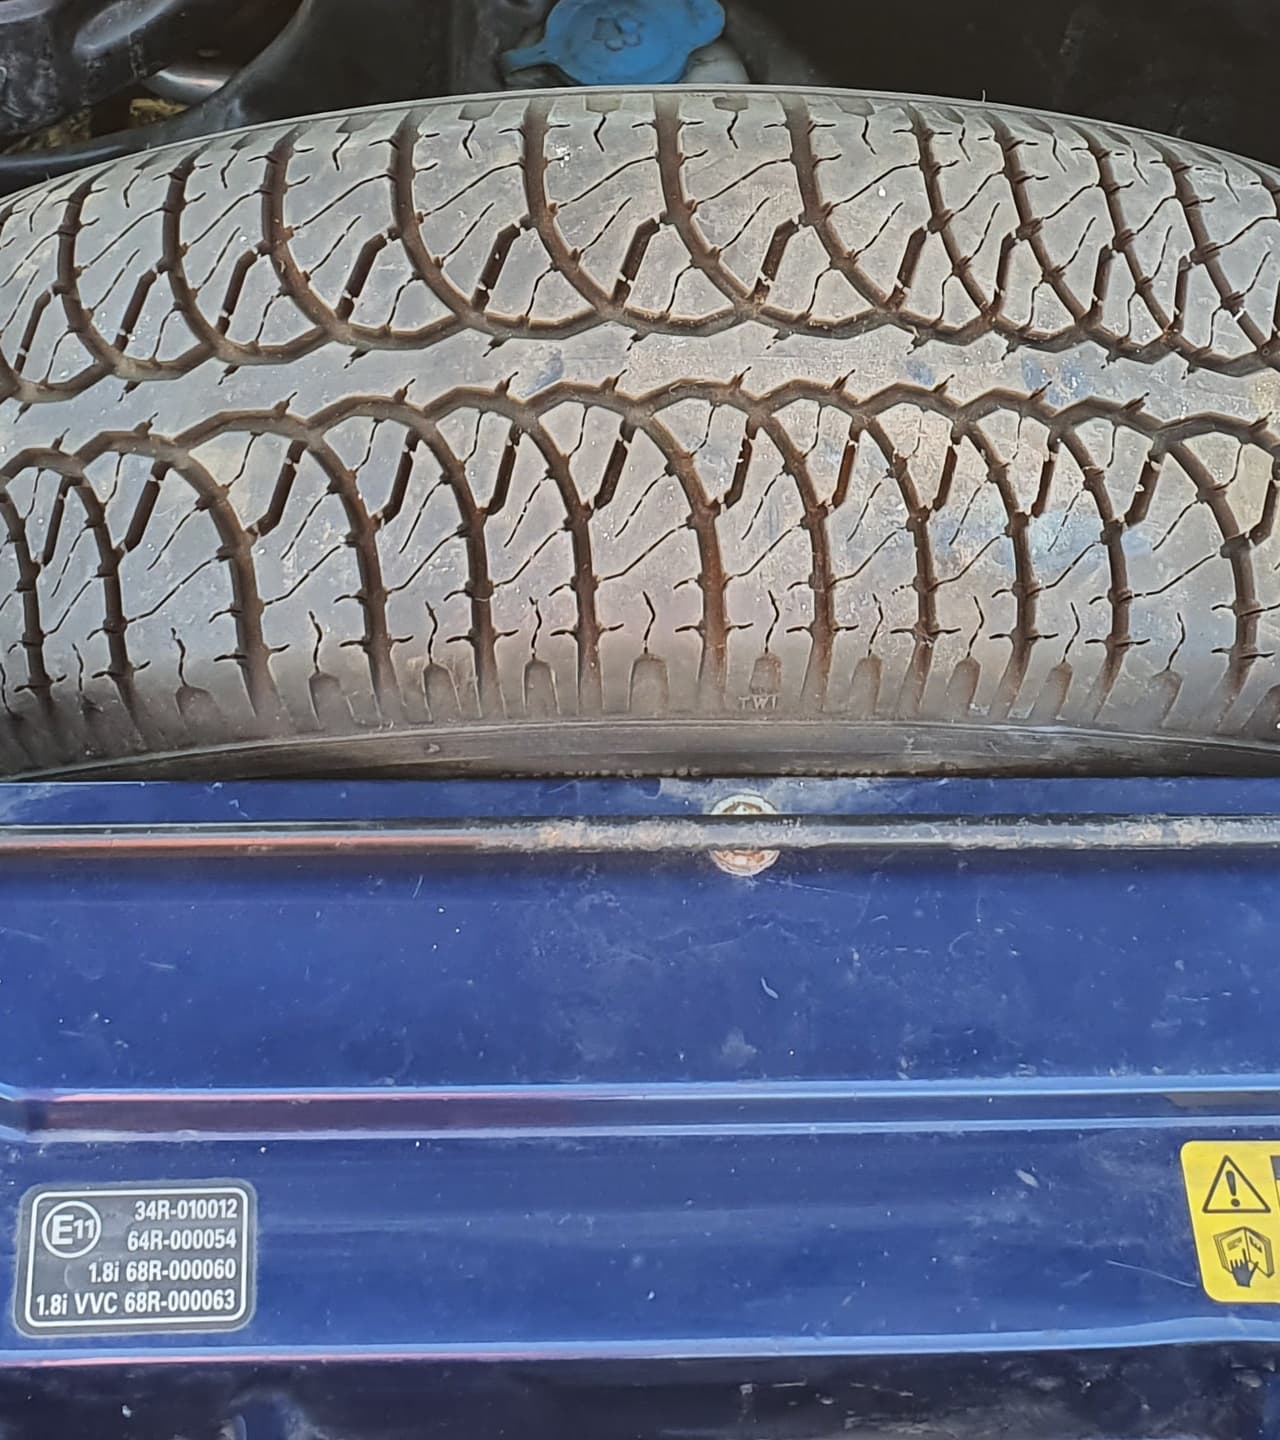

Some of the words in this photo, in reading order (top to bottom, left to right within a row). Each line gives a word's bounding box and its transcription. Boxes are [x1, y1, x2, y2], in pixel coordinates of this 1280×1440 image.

[738, 694, 777, 710] TWI
[134, 1198, 238, 1221] 34R-010012
[51, 1214, 95, 1245] E11
[127, 1228, 237, 1251] 64R-000054
[88, 1261, 120, 1283] 1.8i
[126, 1258, 237, 1282] 68R-000060
[36, 1293, 68, 1316] 1.8i
[74, 1292, 118, 1315] VVC
[124, 1289, 236, 1313] 68R-000063
